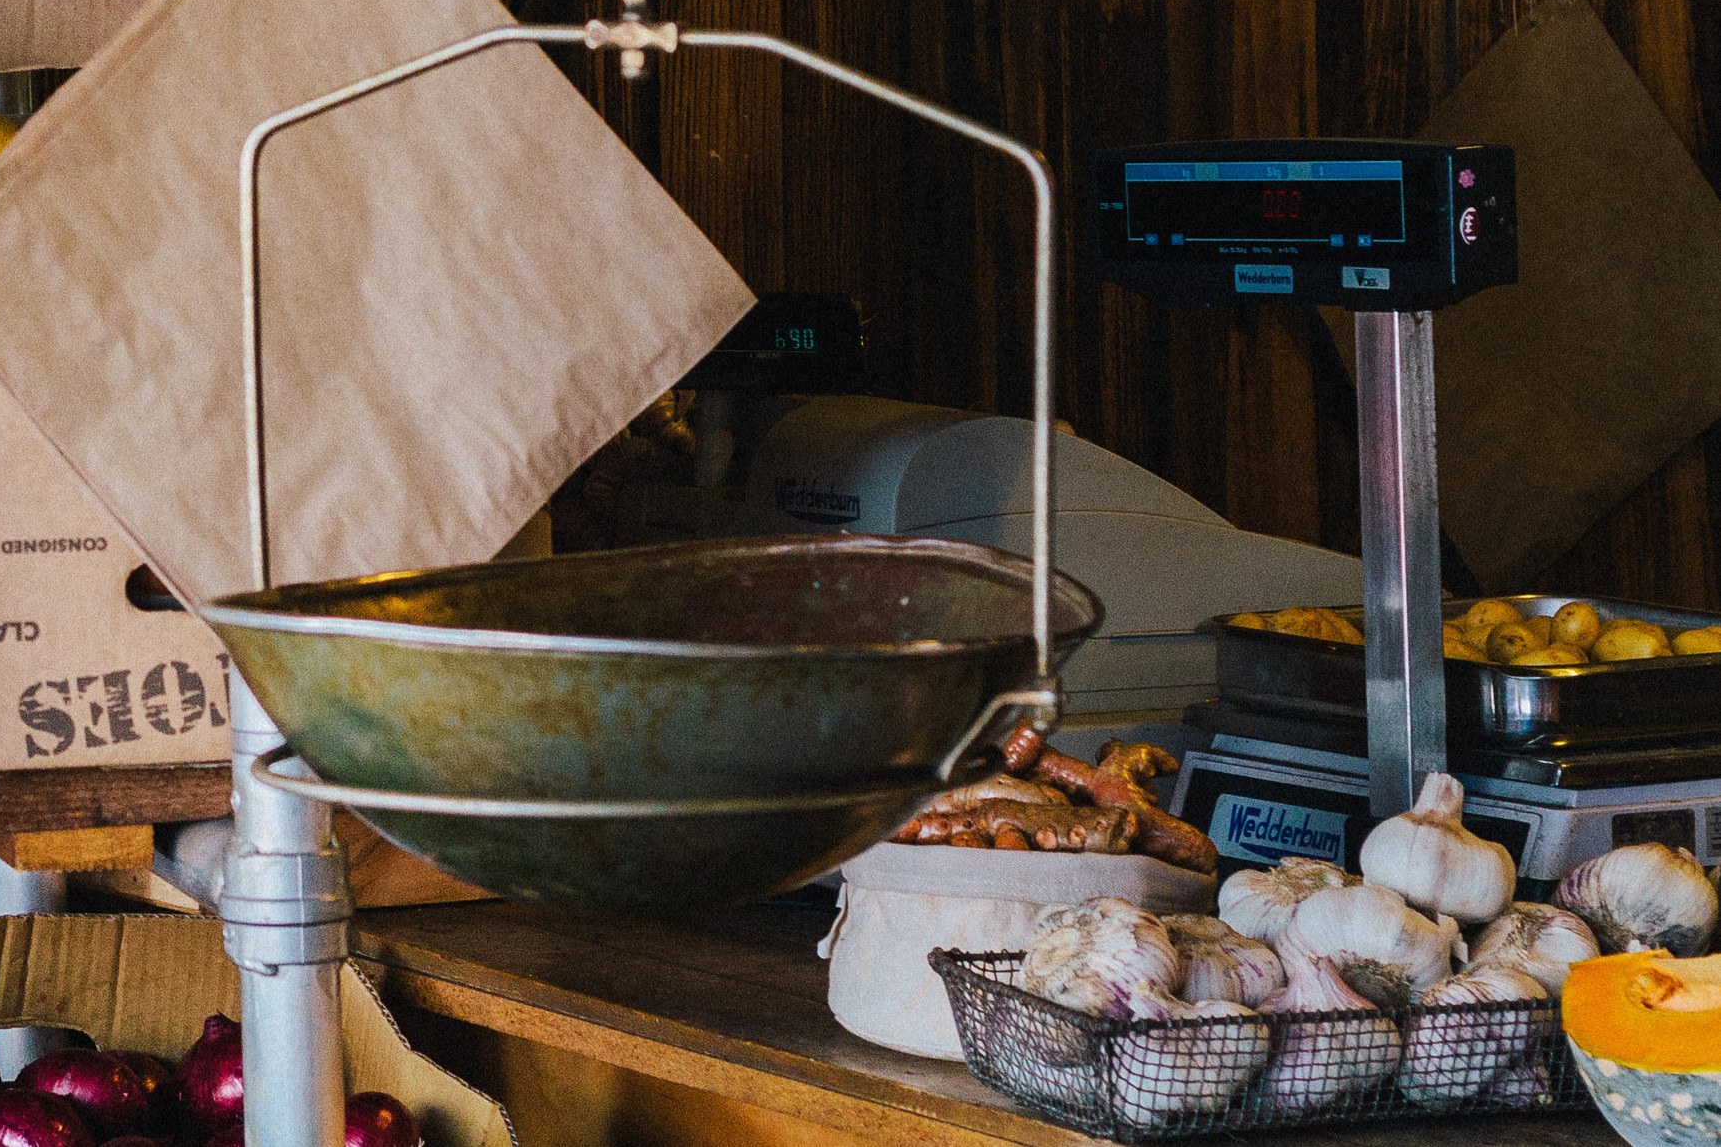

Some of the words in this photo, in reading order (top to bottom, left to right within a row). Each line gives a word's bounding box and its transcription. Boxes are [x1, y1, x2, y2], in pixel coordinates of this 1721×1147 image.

[1237, 270, 1292, 286] Wedderburn
[775, 477, 861, 512] Wedderburn
[0, 536, 108, 554] CONSIGNED
[1229, 802, 1341, 853] Wedderburn
